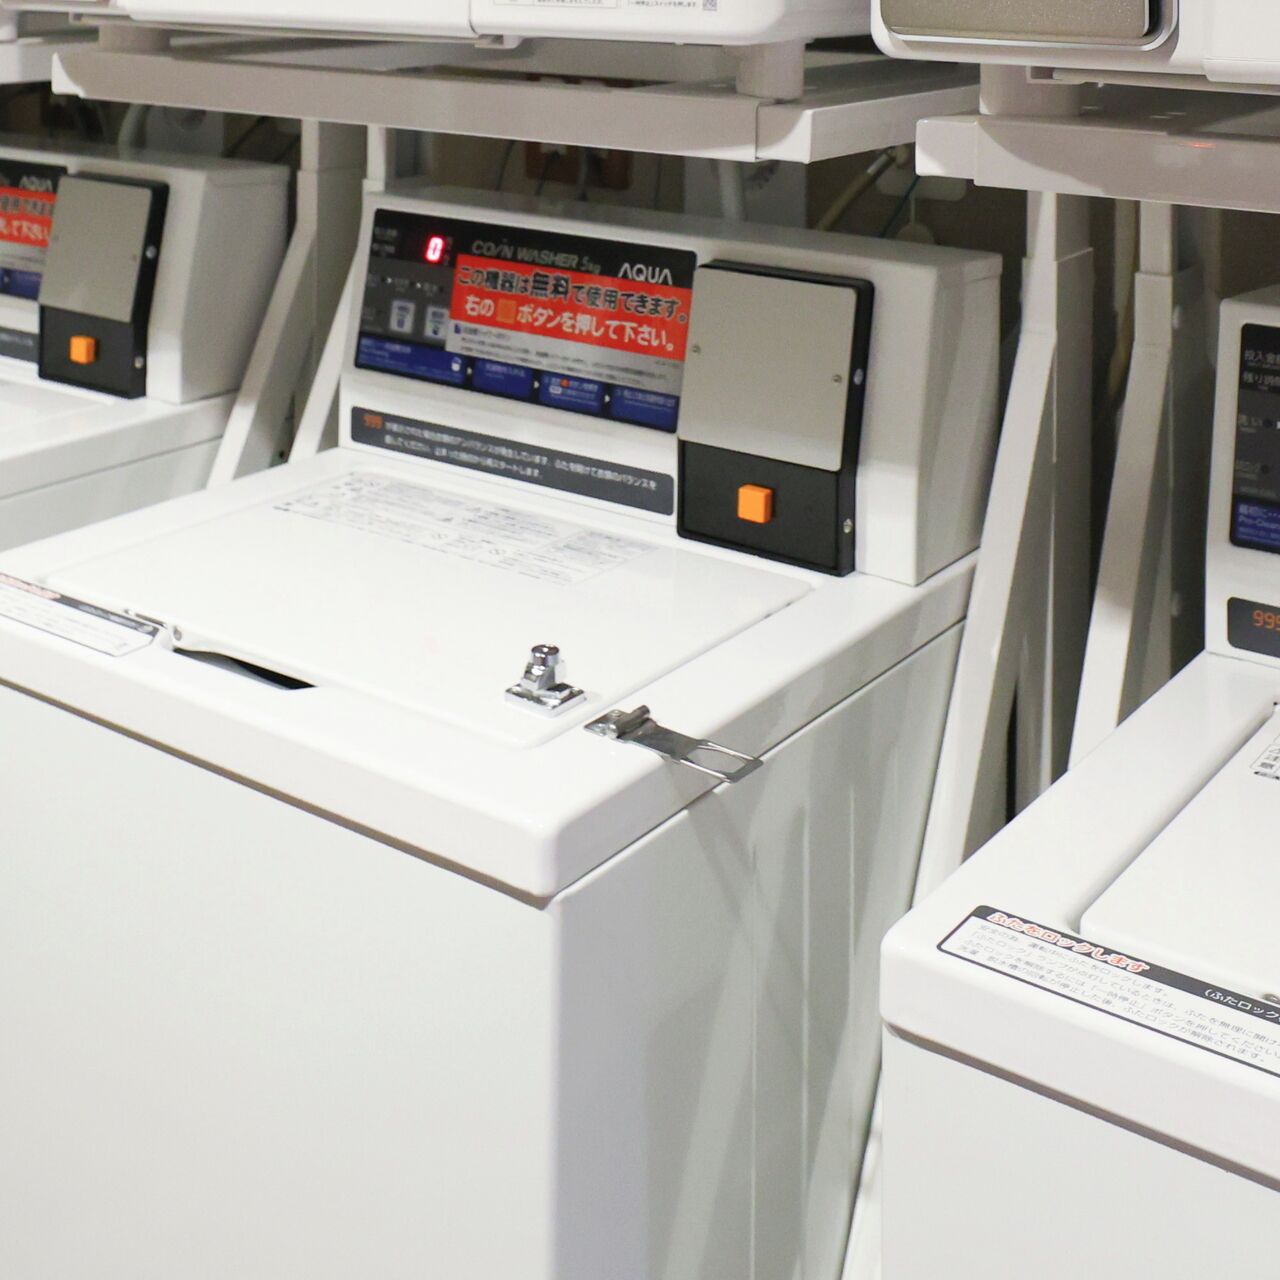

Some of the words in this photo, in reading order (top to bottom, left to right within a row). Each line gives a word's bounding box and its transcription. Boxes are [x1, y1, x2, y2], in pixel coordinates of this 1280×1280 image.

[425, 236, 445, 262] 0
[517, 246, 582, 268] WASHER
[618, 262, 672, 285] AQUA
[457, 266, 686, 324] この機器は無料で使用できます。
[465, 294, 495, 317] 右の
[517, 304, 674, 351] ボタンを押して下さい。
[986, 911, 1150, 973] ふたをロックします
